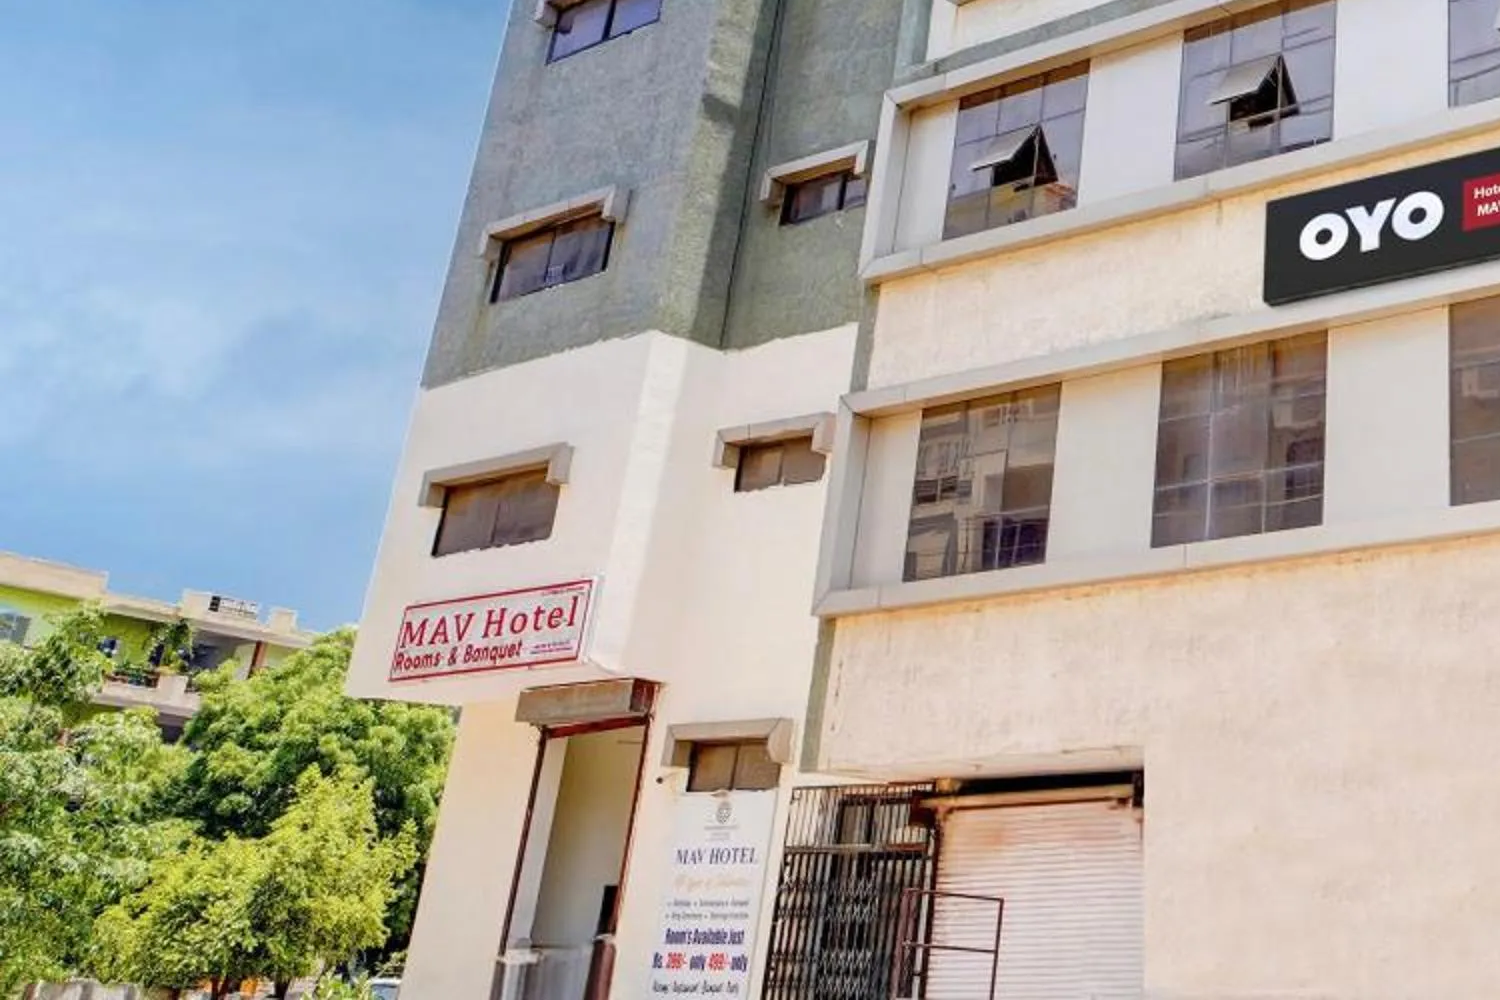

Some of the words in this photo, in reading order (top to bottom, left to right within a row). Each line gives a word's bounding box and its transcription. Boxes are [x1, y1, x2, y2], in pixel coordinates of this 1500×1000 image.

[1299, 190, 1445, 262] OYO
[400, 612, 475, 649] MAV
[481, 595, 580, 639] Hotel
[393, 649, 442, 673] Rooms
[447, 646, 458, 666] &
[463, 640, 524, 666] Banquet
[677, 848, 707, 865] MAV
[709, 847, 758, 865] HOTEL
